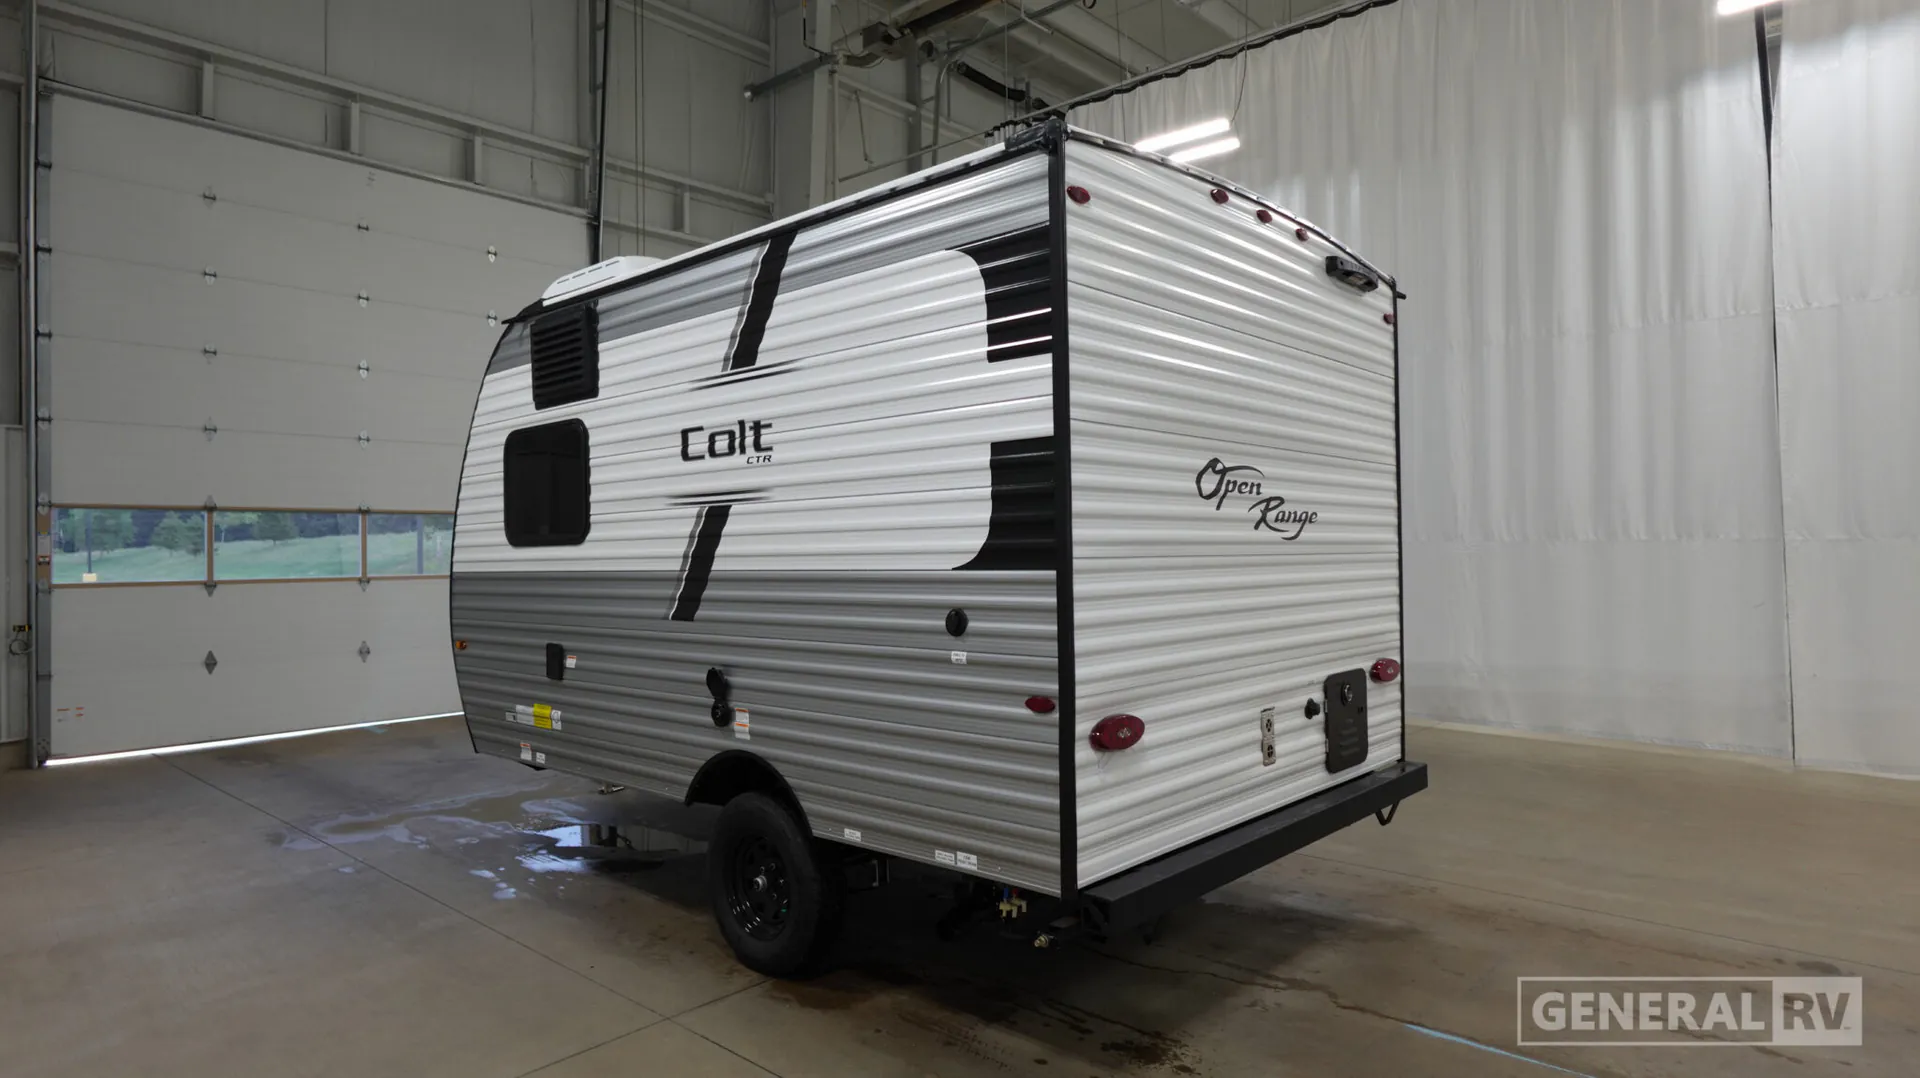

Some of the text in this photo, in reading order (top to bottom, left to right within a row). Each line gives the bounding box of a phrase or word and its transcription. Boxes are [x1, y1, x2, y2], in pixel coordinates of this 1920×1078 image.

[681, 419, 773, 462] Colt
[746, 455, 772, 465] CTR
[1195, 457, 1265, 511] Open
[1247, 496, 1318, 541] Range
